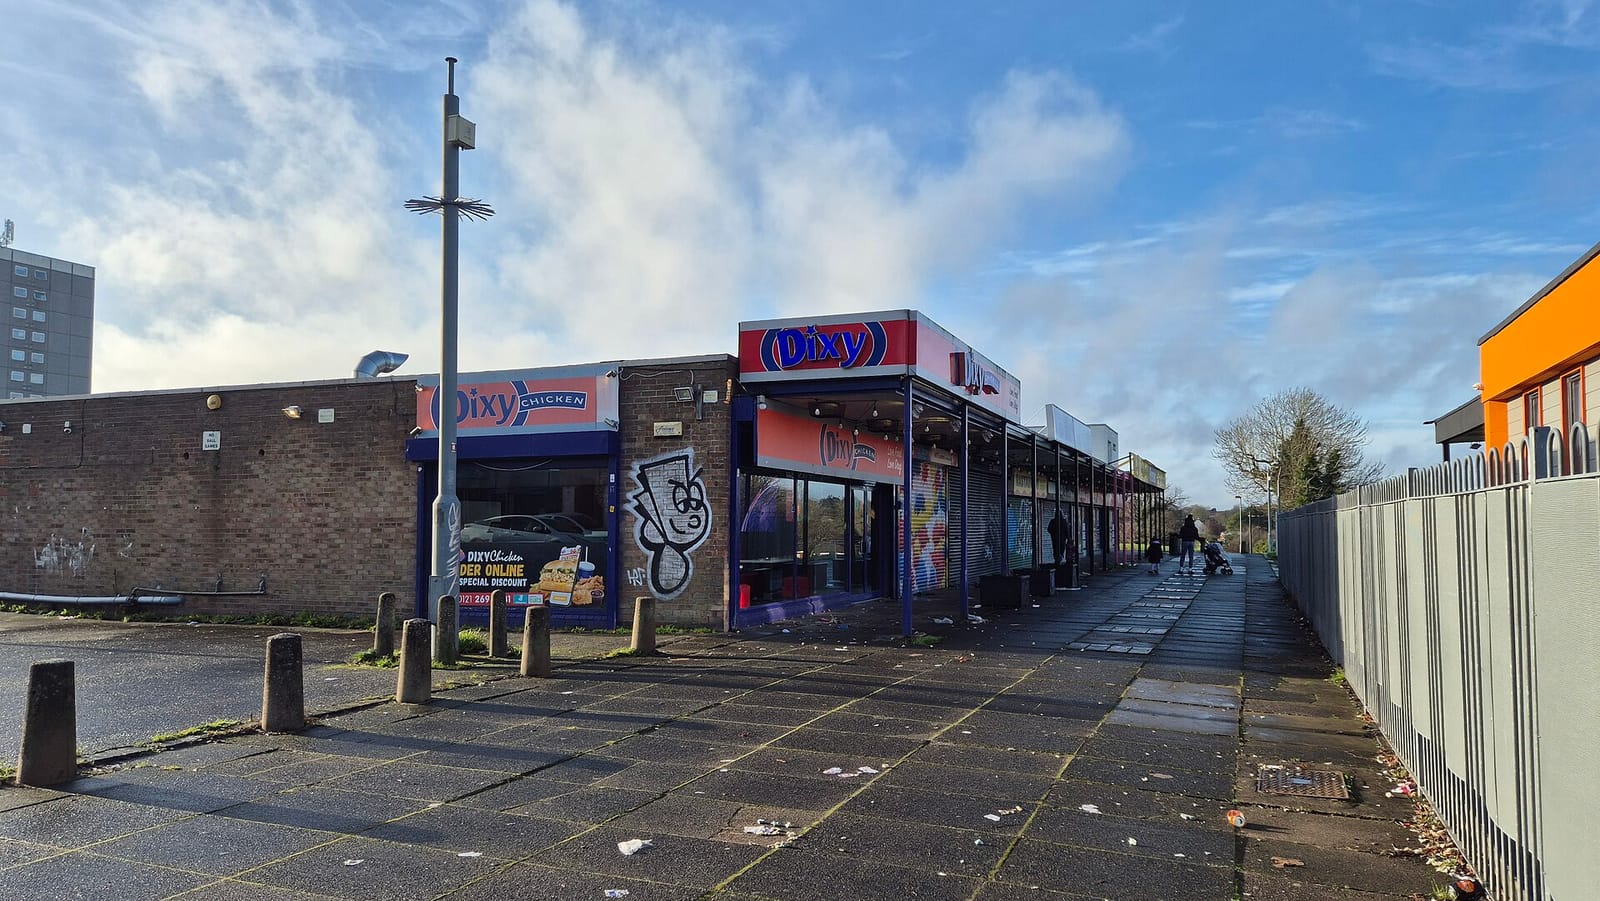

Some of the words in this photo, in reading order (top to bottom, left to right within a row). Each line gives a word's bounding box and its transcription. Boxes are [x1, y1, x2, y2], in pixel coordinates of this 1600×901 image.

[776, 325, 867, 368] Dixy
[522, 395, 585, 408] CHICKEN
[825, 431, 853, 468] Dixy
[485, 564, 525, 577] ONLINE
[459, 577, 489, 587] SPECIAL
[491, 578, 528, 588] DISCOUNT
[474, 595, 490, 603] 269
